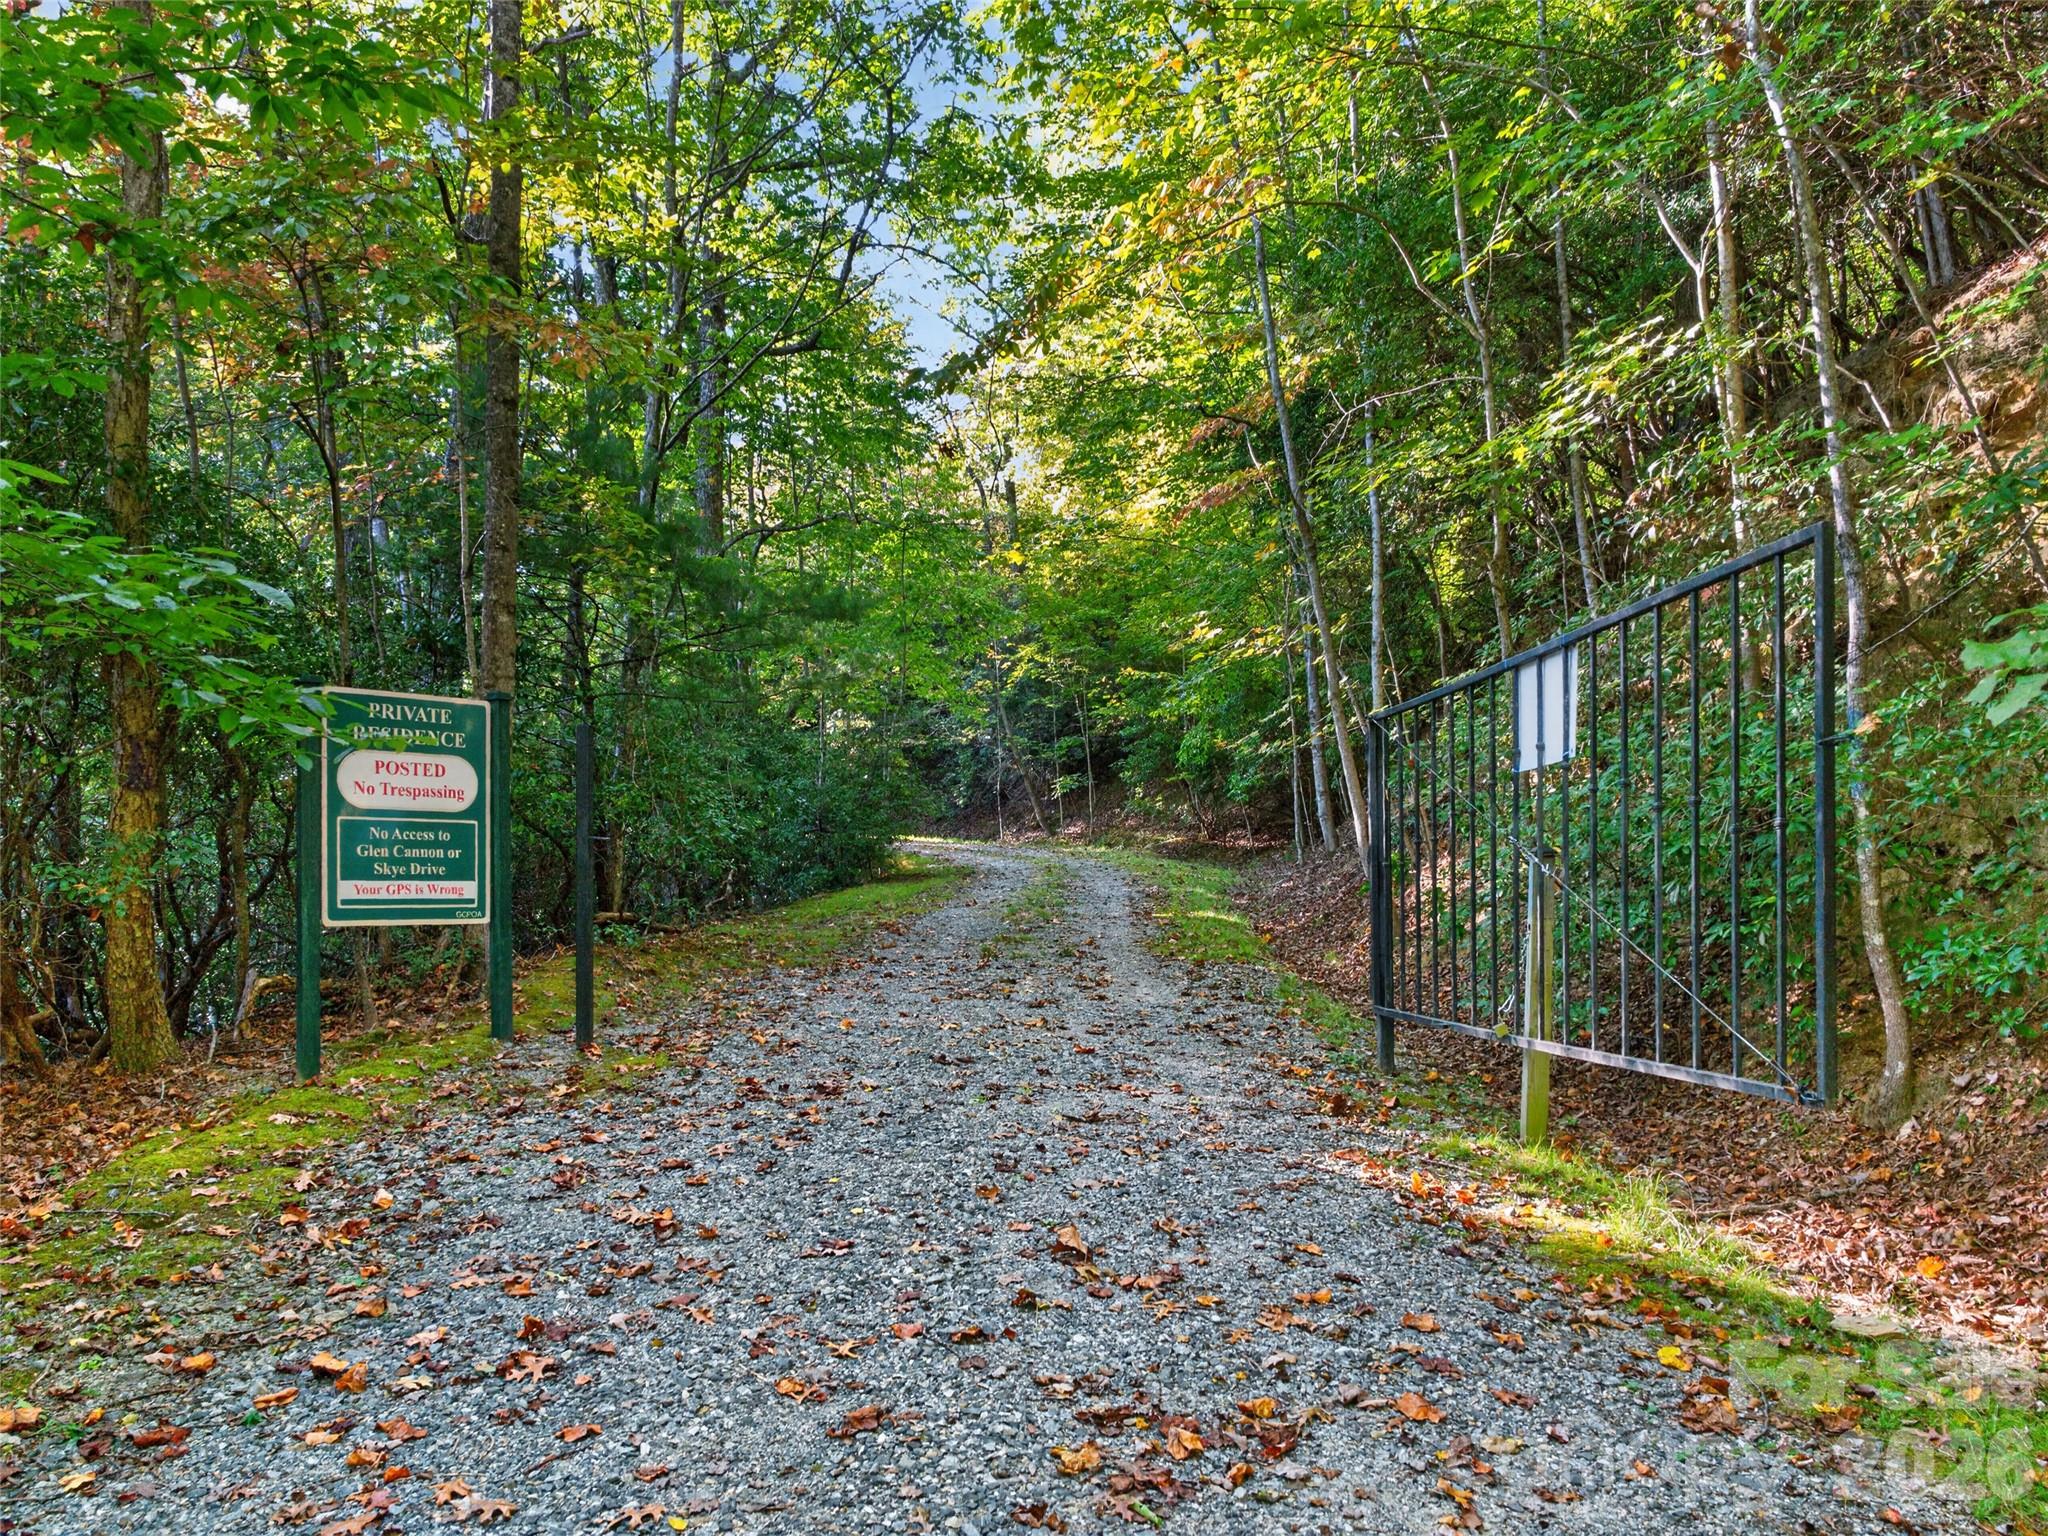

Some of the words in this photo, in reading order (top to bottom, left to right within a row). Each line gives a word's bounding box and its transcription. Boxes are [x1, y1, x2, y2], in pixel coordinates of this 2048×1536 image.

[369, 702, 452, 725] PRIVATE
[374, 760, 446, 777] POSTED
[353, 781, 375, 795] No
[380, 782, 465, 802] Trespassing
[369, 827, 389, 840] No
[391, 827, 434, 841] Access
[438, 830, 450, 841] to
[356, 844, 389, 857] Glen
[393, 845, 444, 858] Cannon
[447, 849, 462, 859] or
[374, 863, 406, 878] Skye
[410, 864, 446, 876] Drive
[354, 884, 382, 896] Your
[386, 884, 412, 896] GPS
[415, 884, 424, 895] is
[427, 884, 464, 897] Wrong
